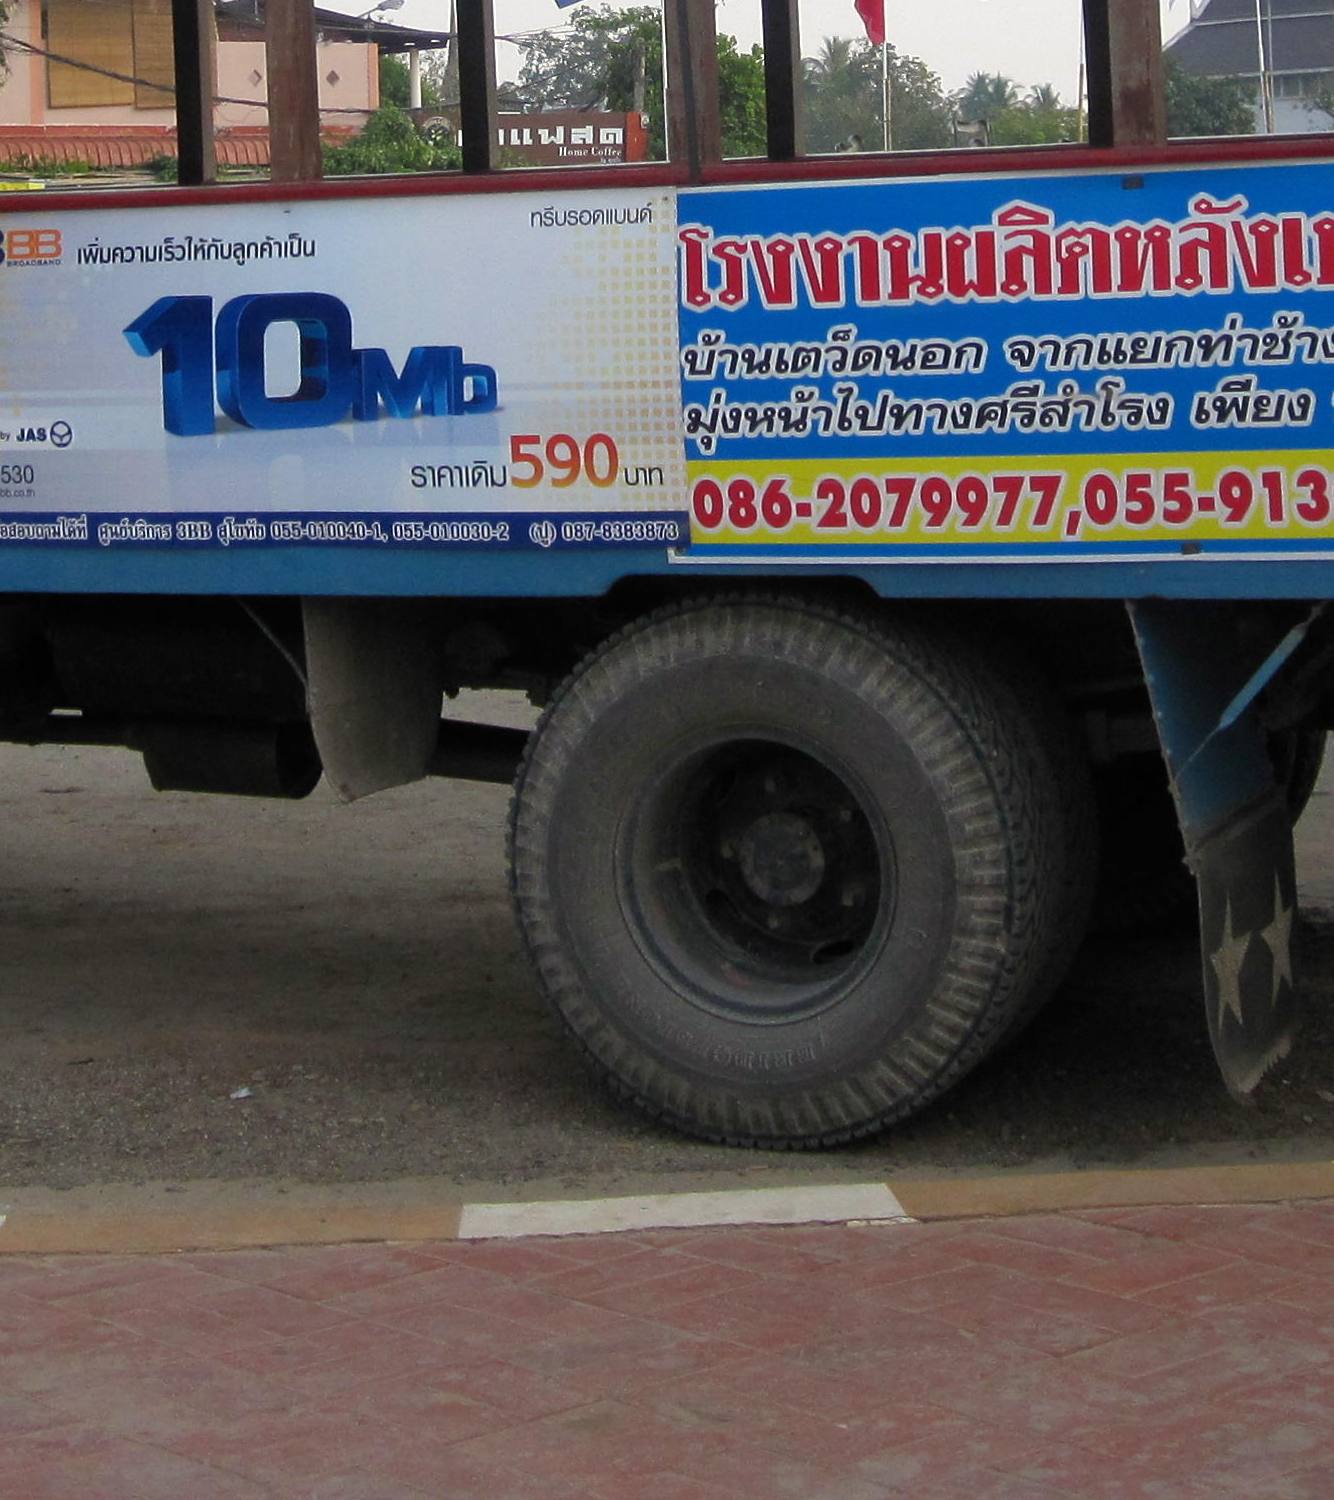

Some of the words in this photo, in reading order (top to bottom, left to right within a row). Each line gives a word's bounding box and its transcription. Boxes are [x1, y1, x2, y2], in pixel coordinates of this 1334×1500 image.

[531, 203, 652, 228] ทรีบรอดแบนด์
[77, 233, 316, 267] เพิ่มความเร็วให้กับลูกค้าเป็น
[684, 325, 987, 379] บ้านเตว็ดนอก
[686, 379, 1169, 454] มุ่งหน้าไปทางศรีสำโรง
[1194, 376, 1314, 426] เพียง
[0, 431, 11, 442] by
[16, 427, 47, 442] JAS
[510, 433, 619, 489] 590
[176, 521, 212, 539] 3BB
[217, 516, 267, 546] สุโขทัย
